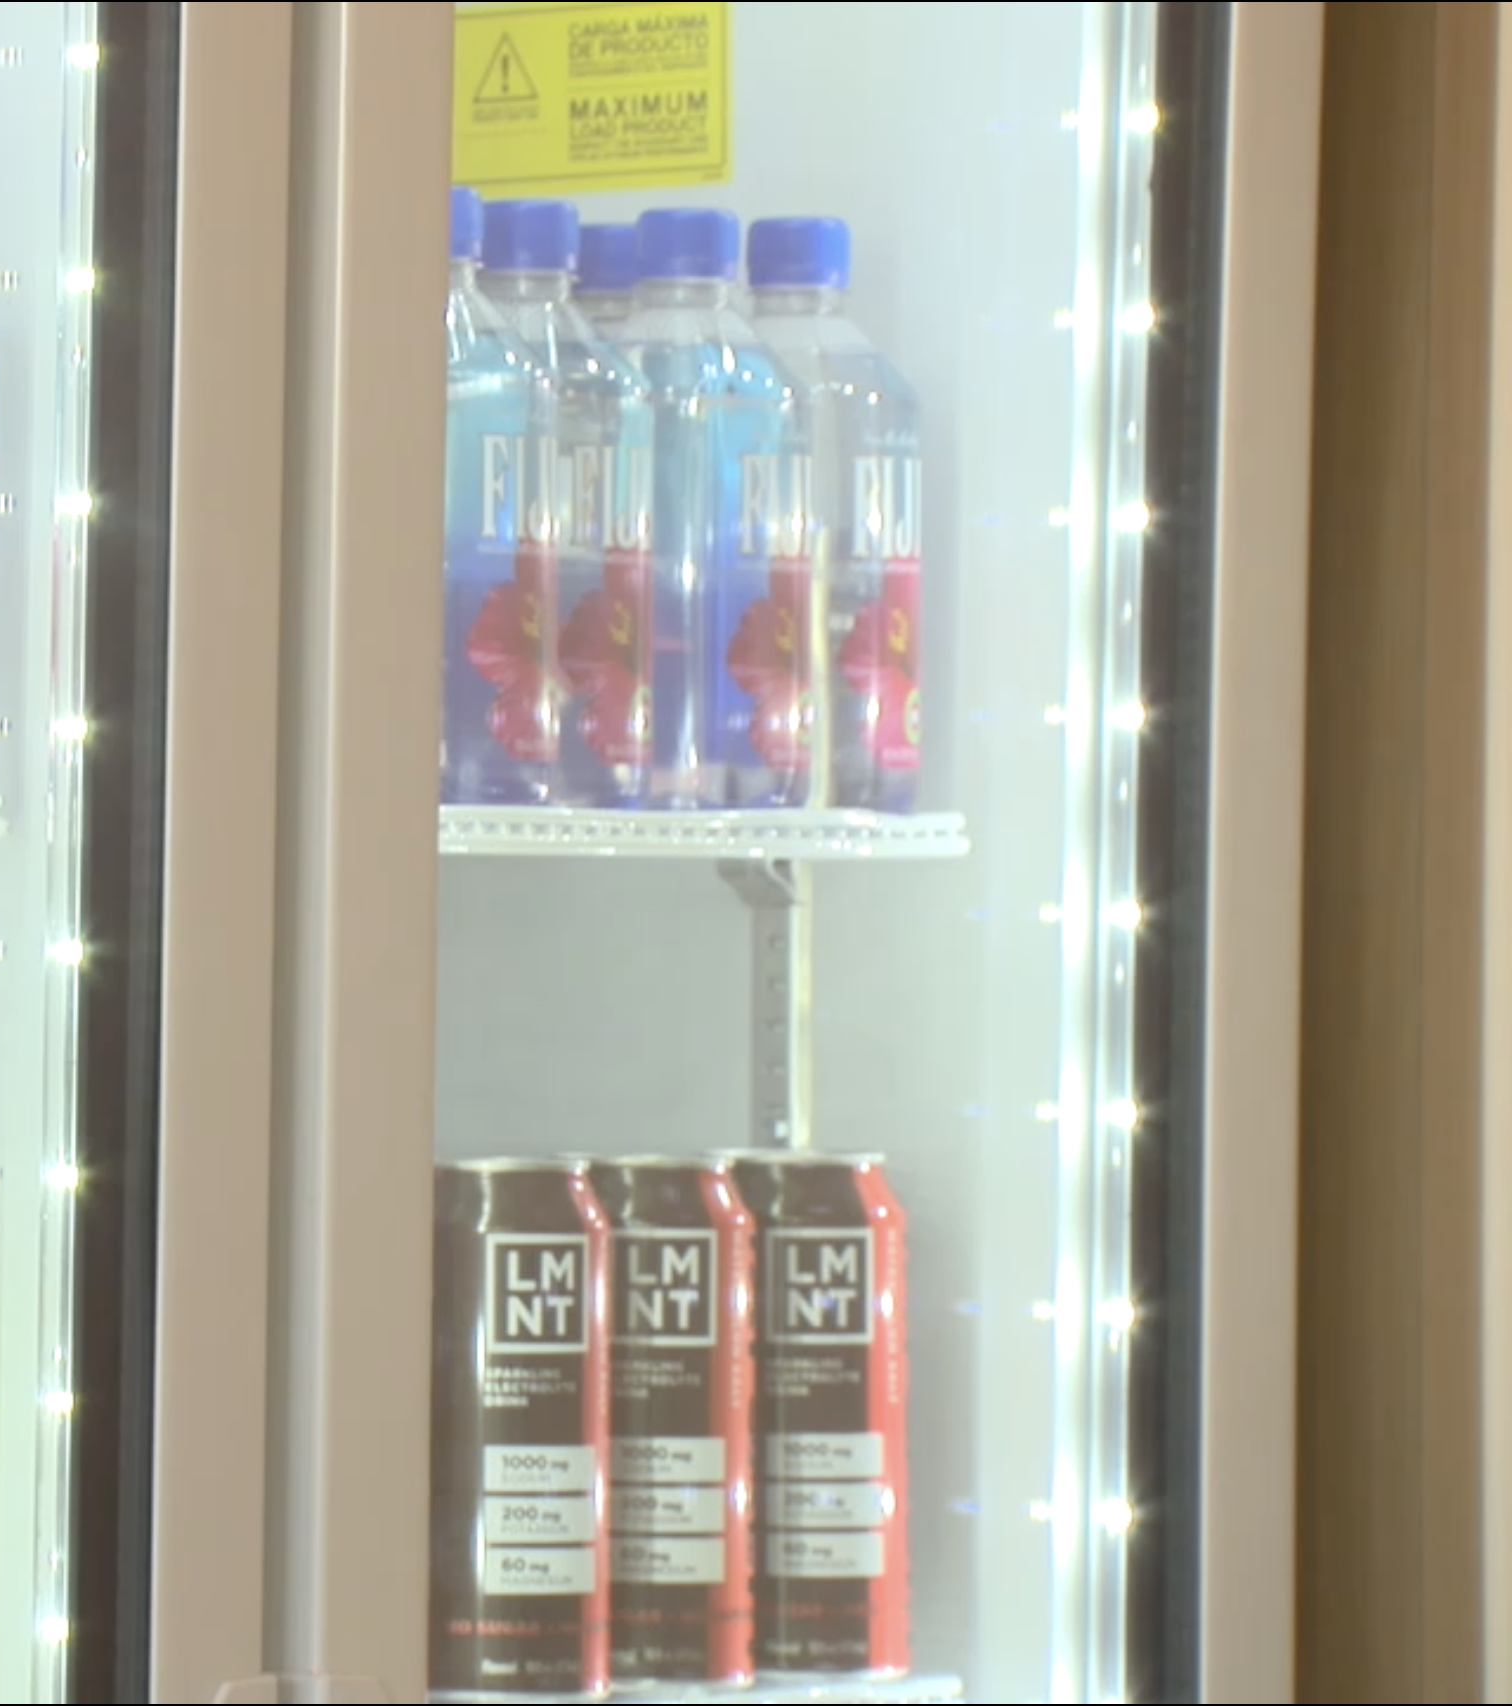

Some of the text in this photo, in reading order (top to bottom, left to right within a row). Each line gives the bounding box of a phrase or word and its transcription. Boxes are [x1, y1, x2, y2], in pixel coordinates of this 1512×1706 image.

[570, 90, 707, 119] MAXIMUM
[851, 456, 922, 558] FIJI
[506, 1250, 575, 1291] LM
[628, 1244, 699, 1286] LM
[787, 1244, 858, 1285] LM
[506, 1295, 574, 1336] NT
[628, 1287, 699, 1331] NT
[787, 1287, 858, 1329] NT
[502, 1455, 569, 1471] 1000 mg
[502, 1506, 562, 1523] 200 mg
[501, 1557, 550, 1574] 60 mg
